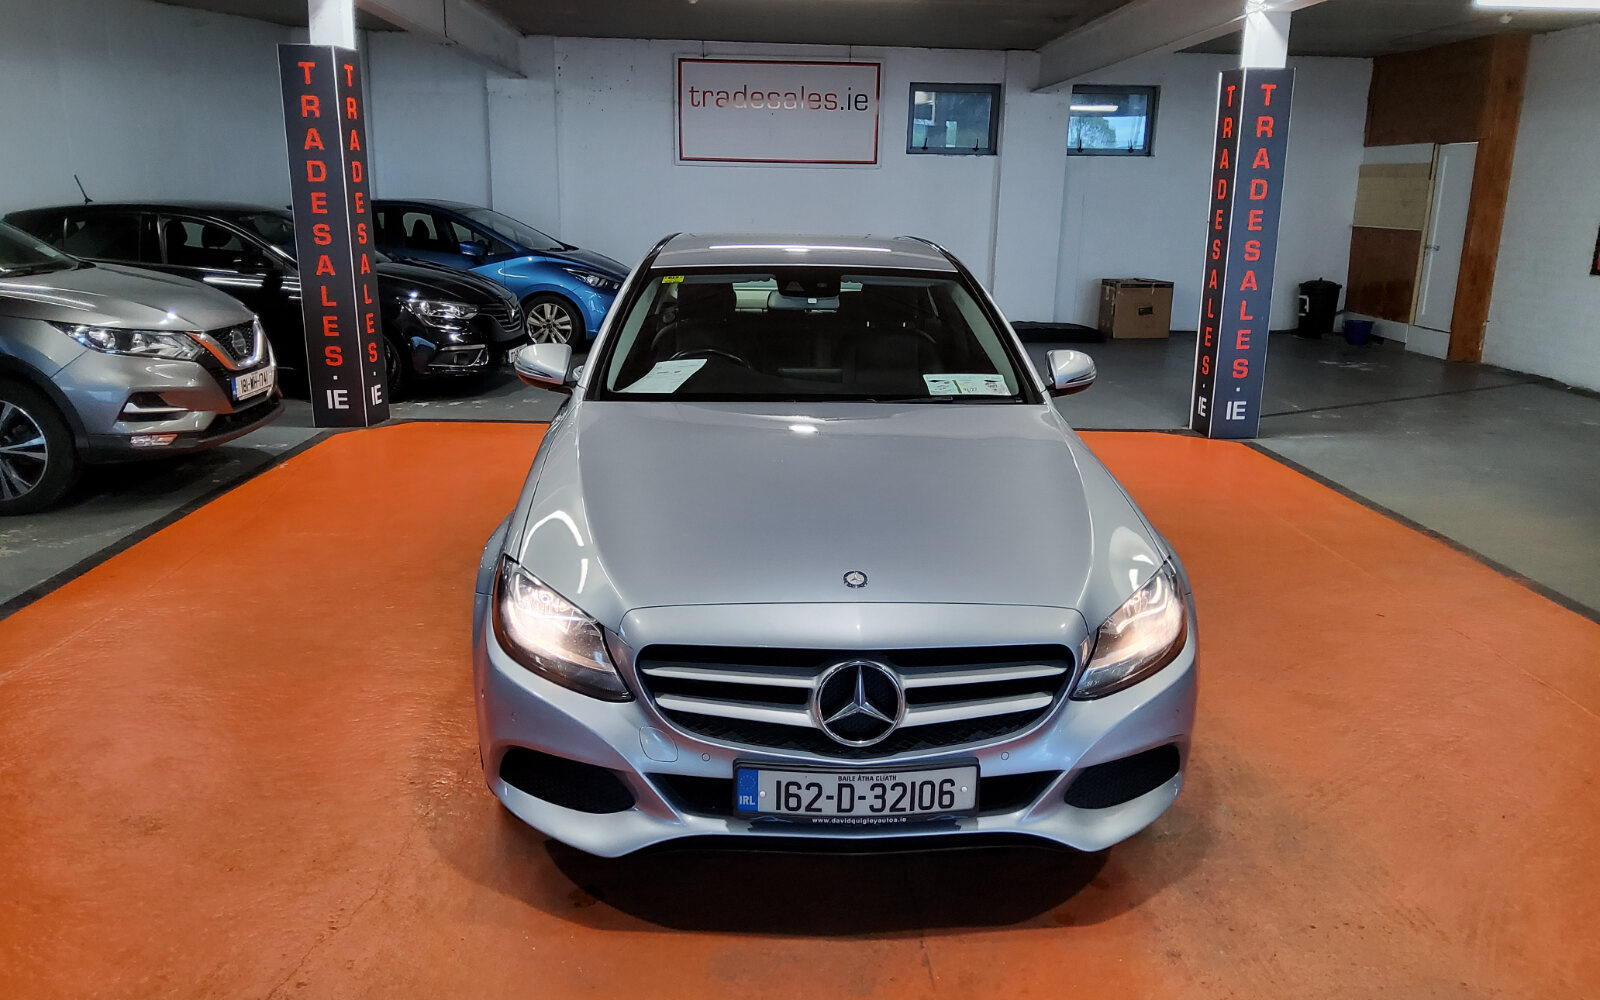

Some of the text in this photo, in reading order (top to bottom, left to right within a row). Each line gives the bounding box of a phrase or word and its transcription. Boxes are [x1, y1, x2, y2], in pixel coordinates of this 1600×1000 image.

[689, 84, 869, 111] tradesales.ie
[739, 795, 756, 806] IRL
[775, 778, 956, 813] 162-D-32106
